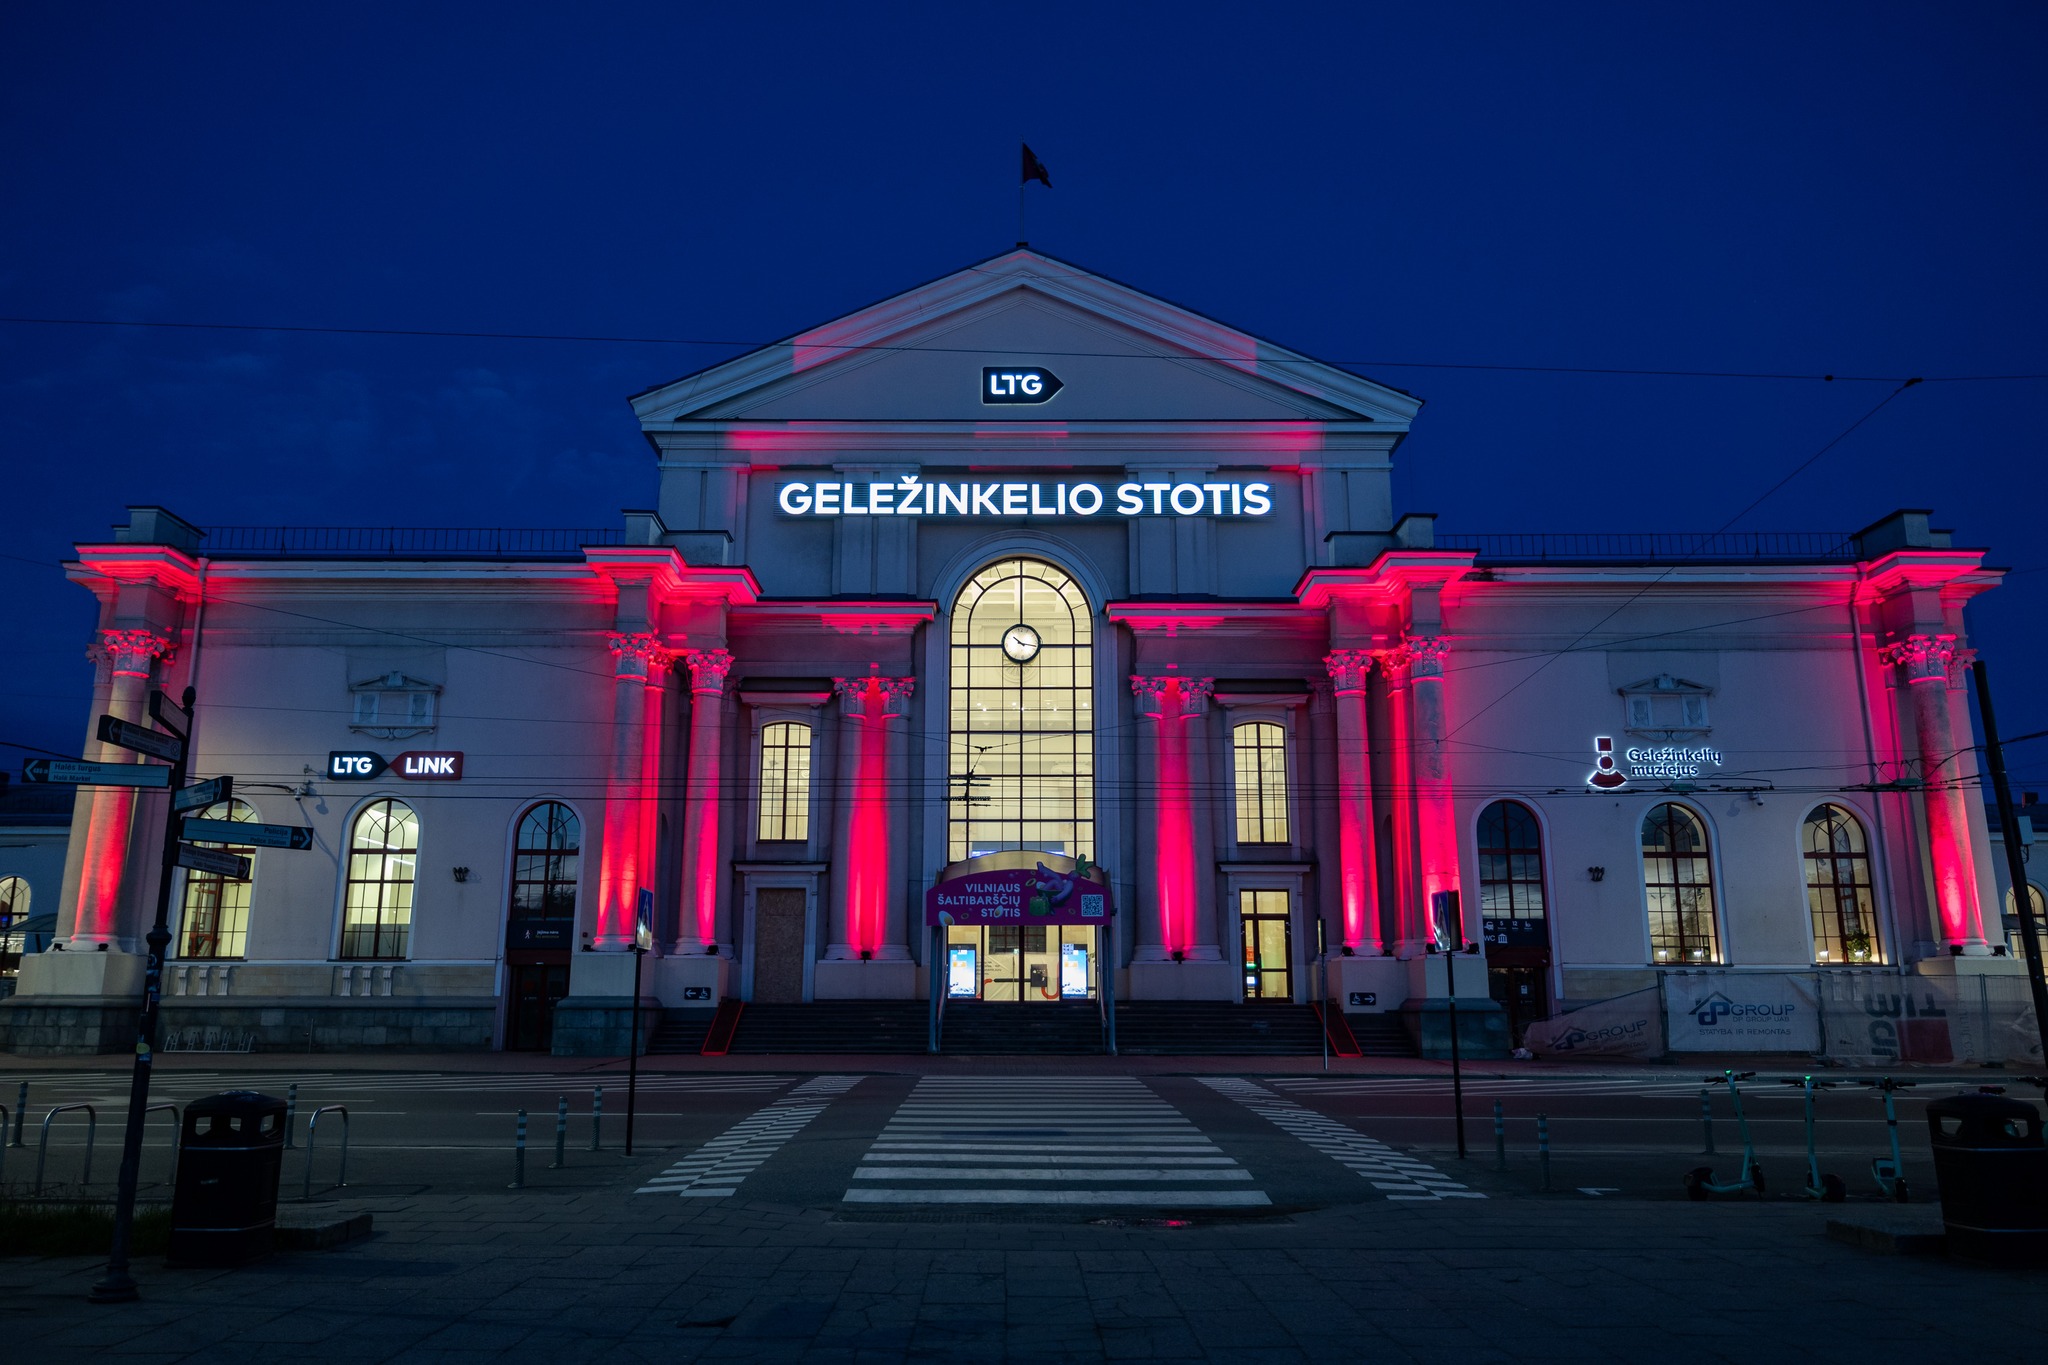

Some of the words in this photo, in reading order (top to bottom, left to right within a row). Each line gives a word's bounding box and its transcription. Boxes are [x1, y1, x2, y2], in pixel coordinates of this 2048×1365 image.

[990, 374, 1043, 395] LTG
[778, 475, 1104, 516] GELEŽINKELIO
[1116, 482, 1271, 516] STOTIS
[333, 756, 373, 774] LTG
[405, 756, 456, 774] LINK
[1627, 747, 1722, 766] Geležinkelių
[1630, 762, 1699, 778] muziejus
[965, 883, 1021, 893] VILNIAUS
[937, 893, 1021, 907] ŠALTIBARŠČIŲ
[1730, 1004, 1795, 1016] GROUP
[1585, 1019, 1648, 1041] GROUP
[1699, 1028, 1733, 1036] STATYBA
